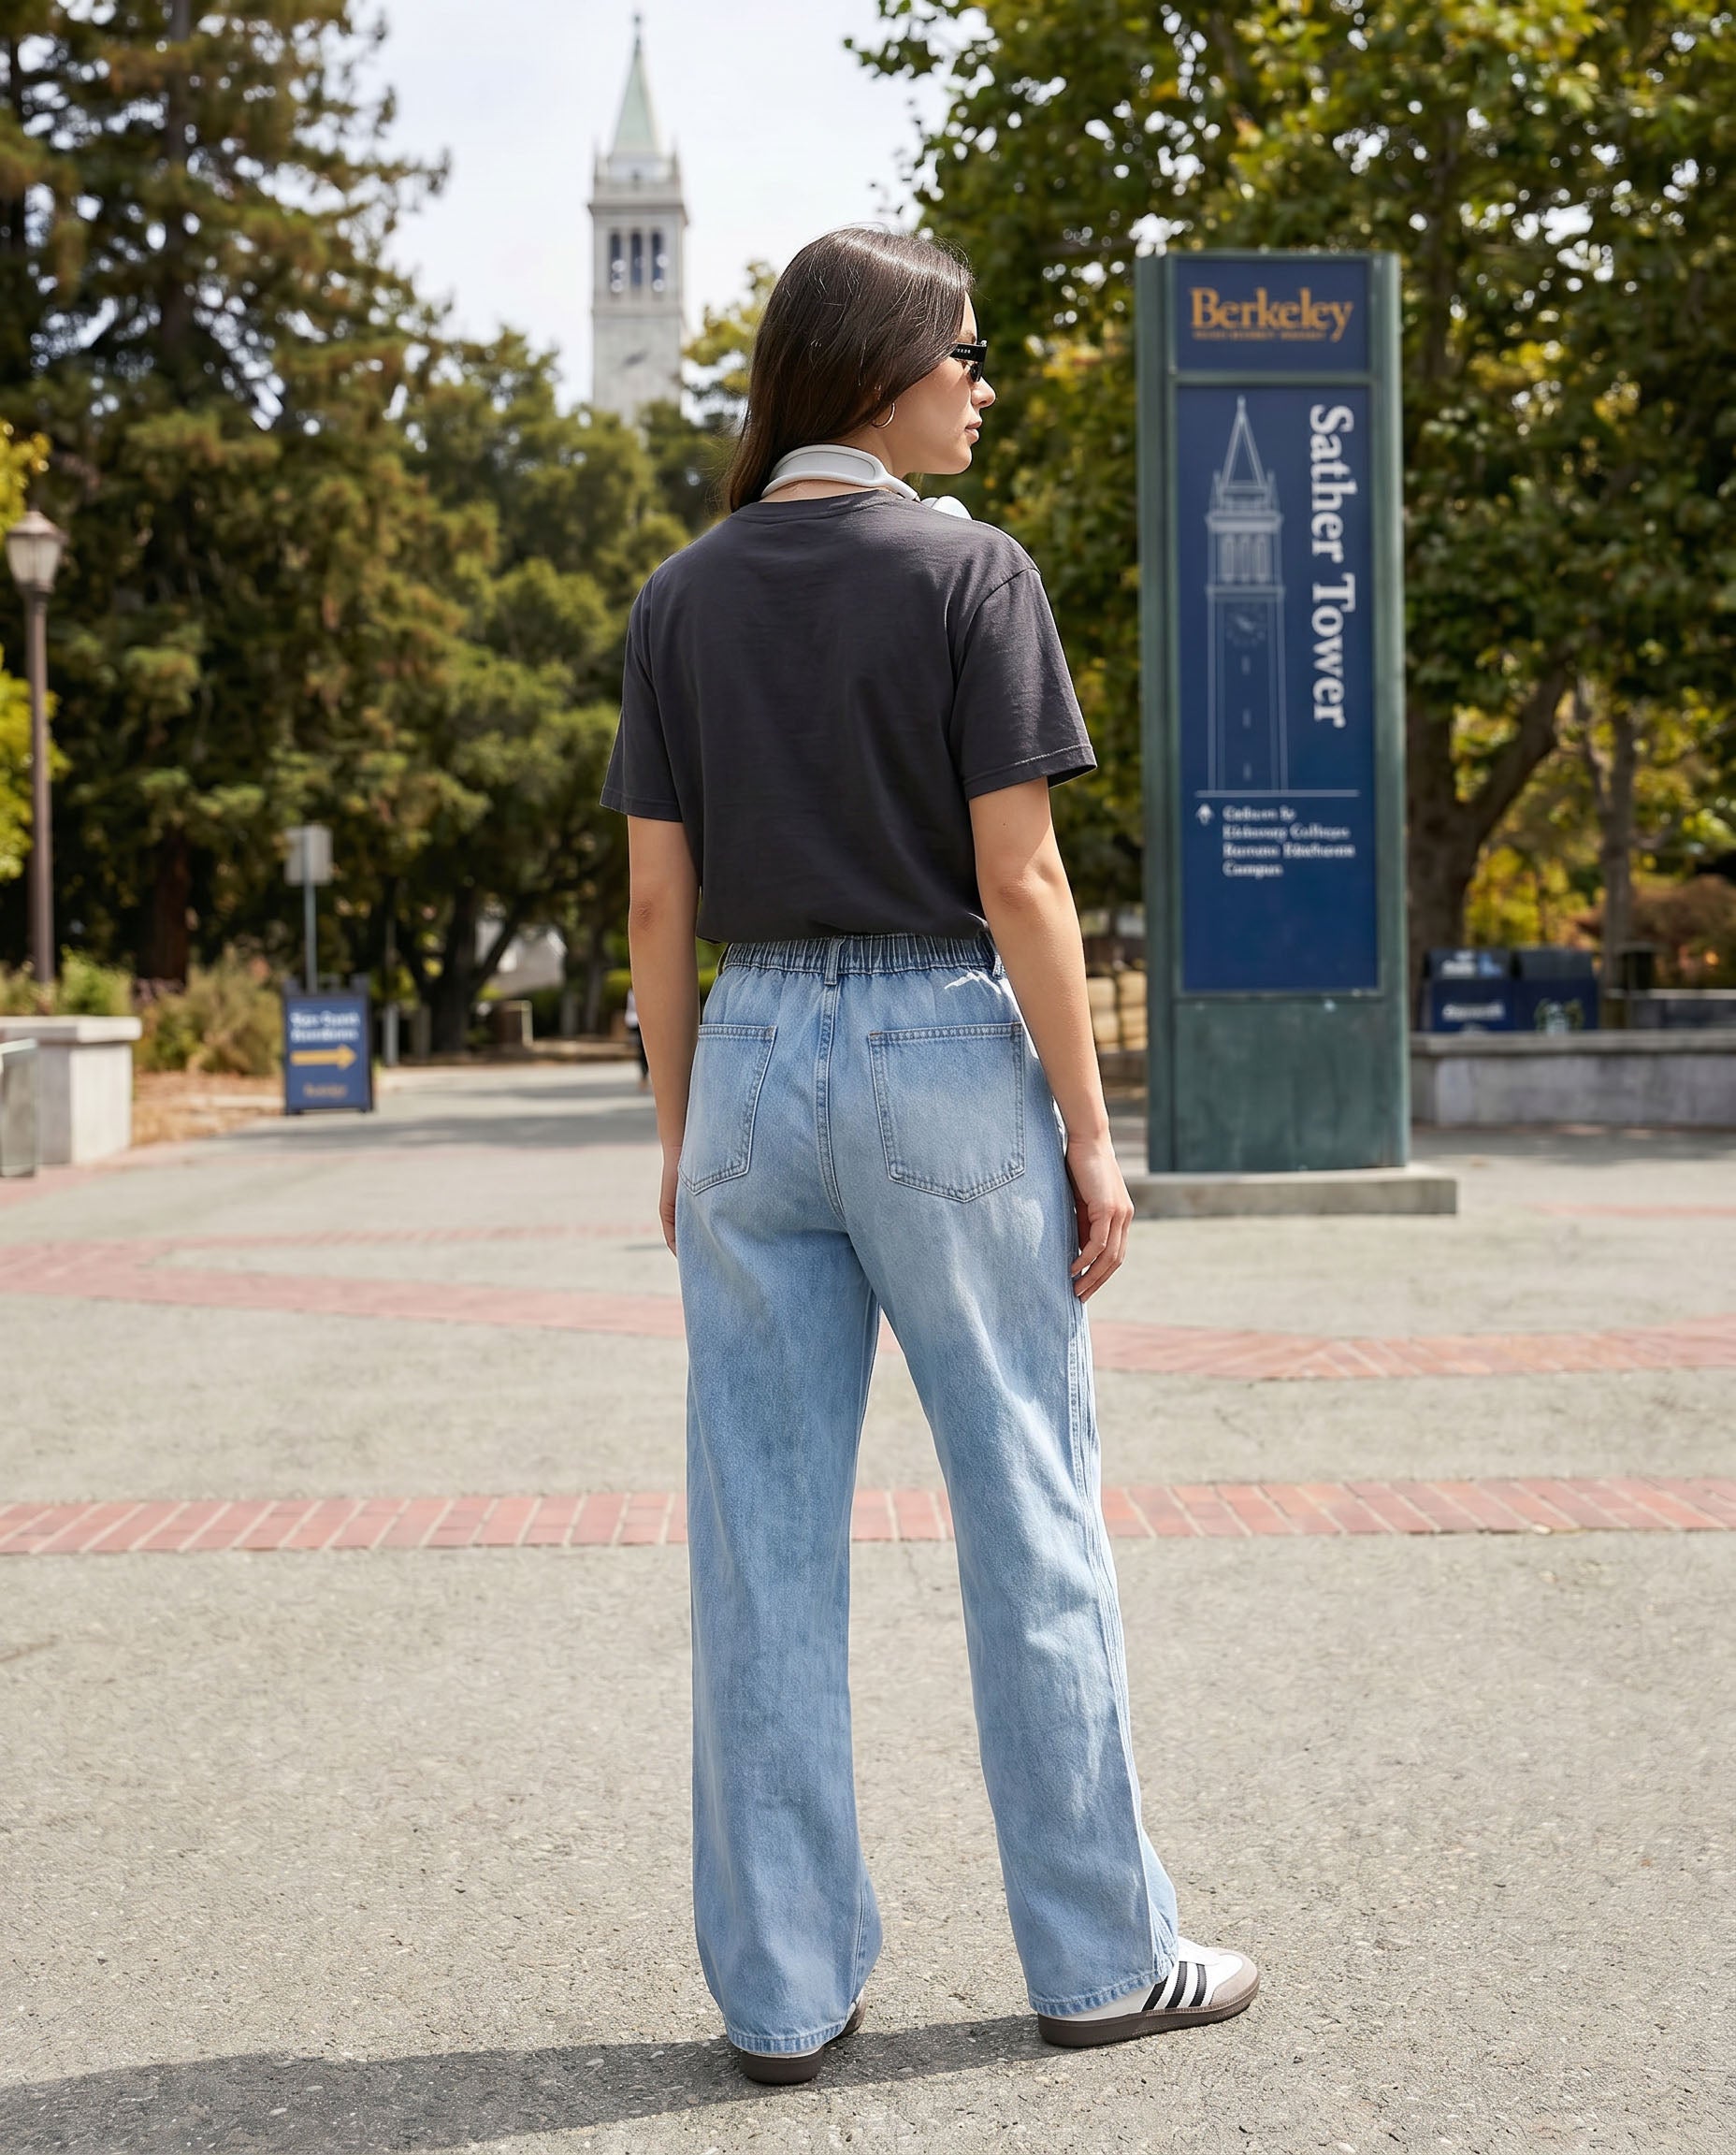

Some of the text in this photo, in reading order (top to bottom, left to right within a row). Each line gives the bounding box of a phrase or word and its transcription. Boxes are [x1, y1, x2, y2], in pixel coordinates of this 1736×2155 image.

[1190, 287, 1353, 341] Berkeley
[1310, 404, 1357, 729] Sather Tower
